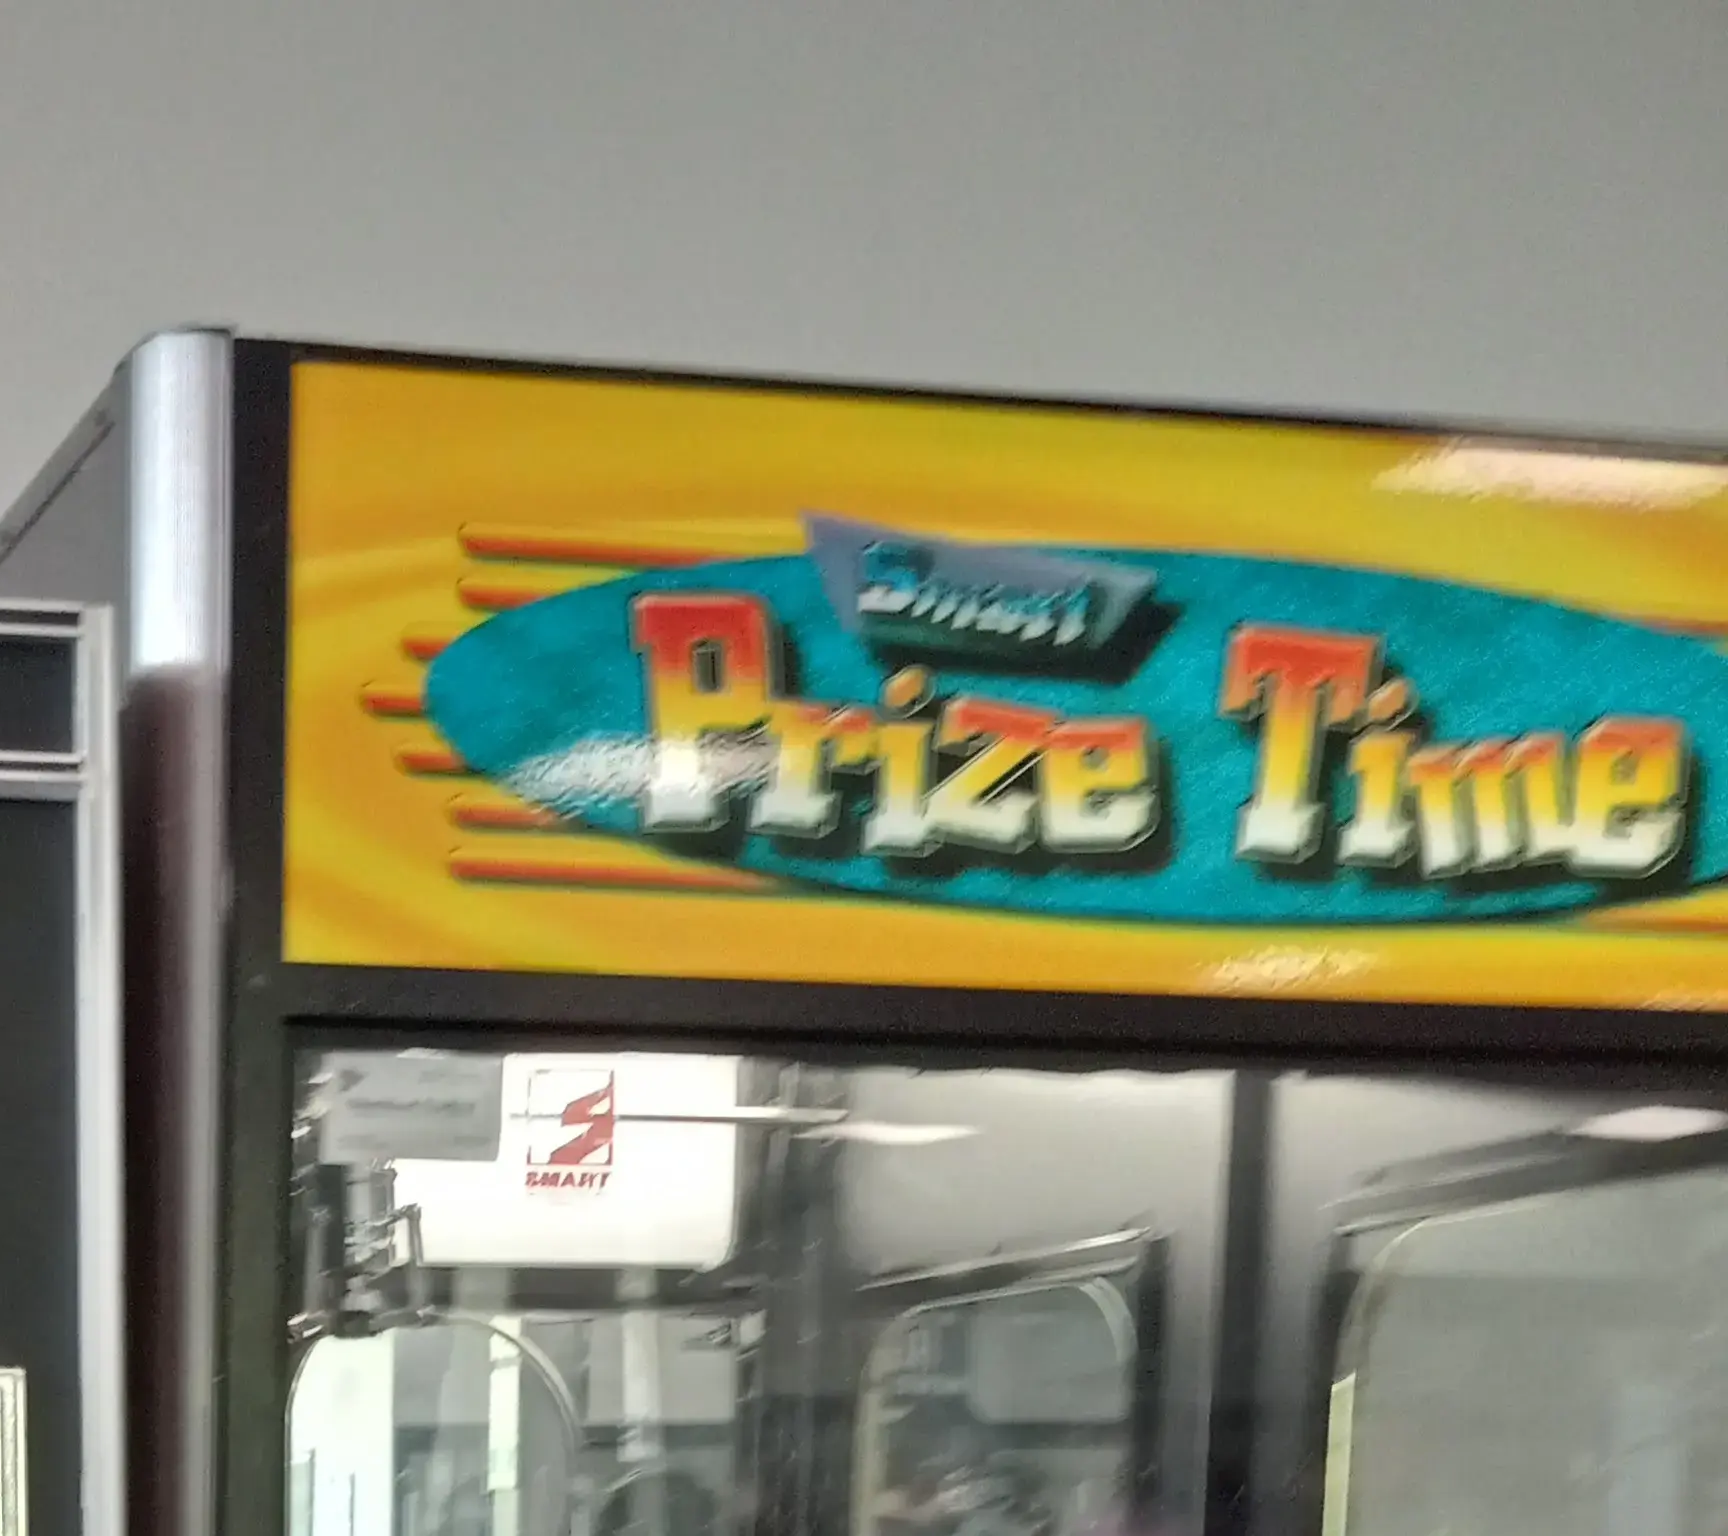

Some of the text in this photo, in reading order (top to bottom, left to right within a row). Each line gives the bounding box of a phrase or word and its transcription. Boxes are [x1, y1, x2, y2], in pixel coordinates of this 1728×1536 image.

[634, 590, 1690, 882] Prize Time
[524, 1169, 613, 1192] SMART
